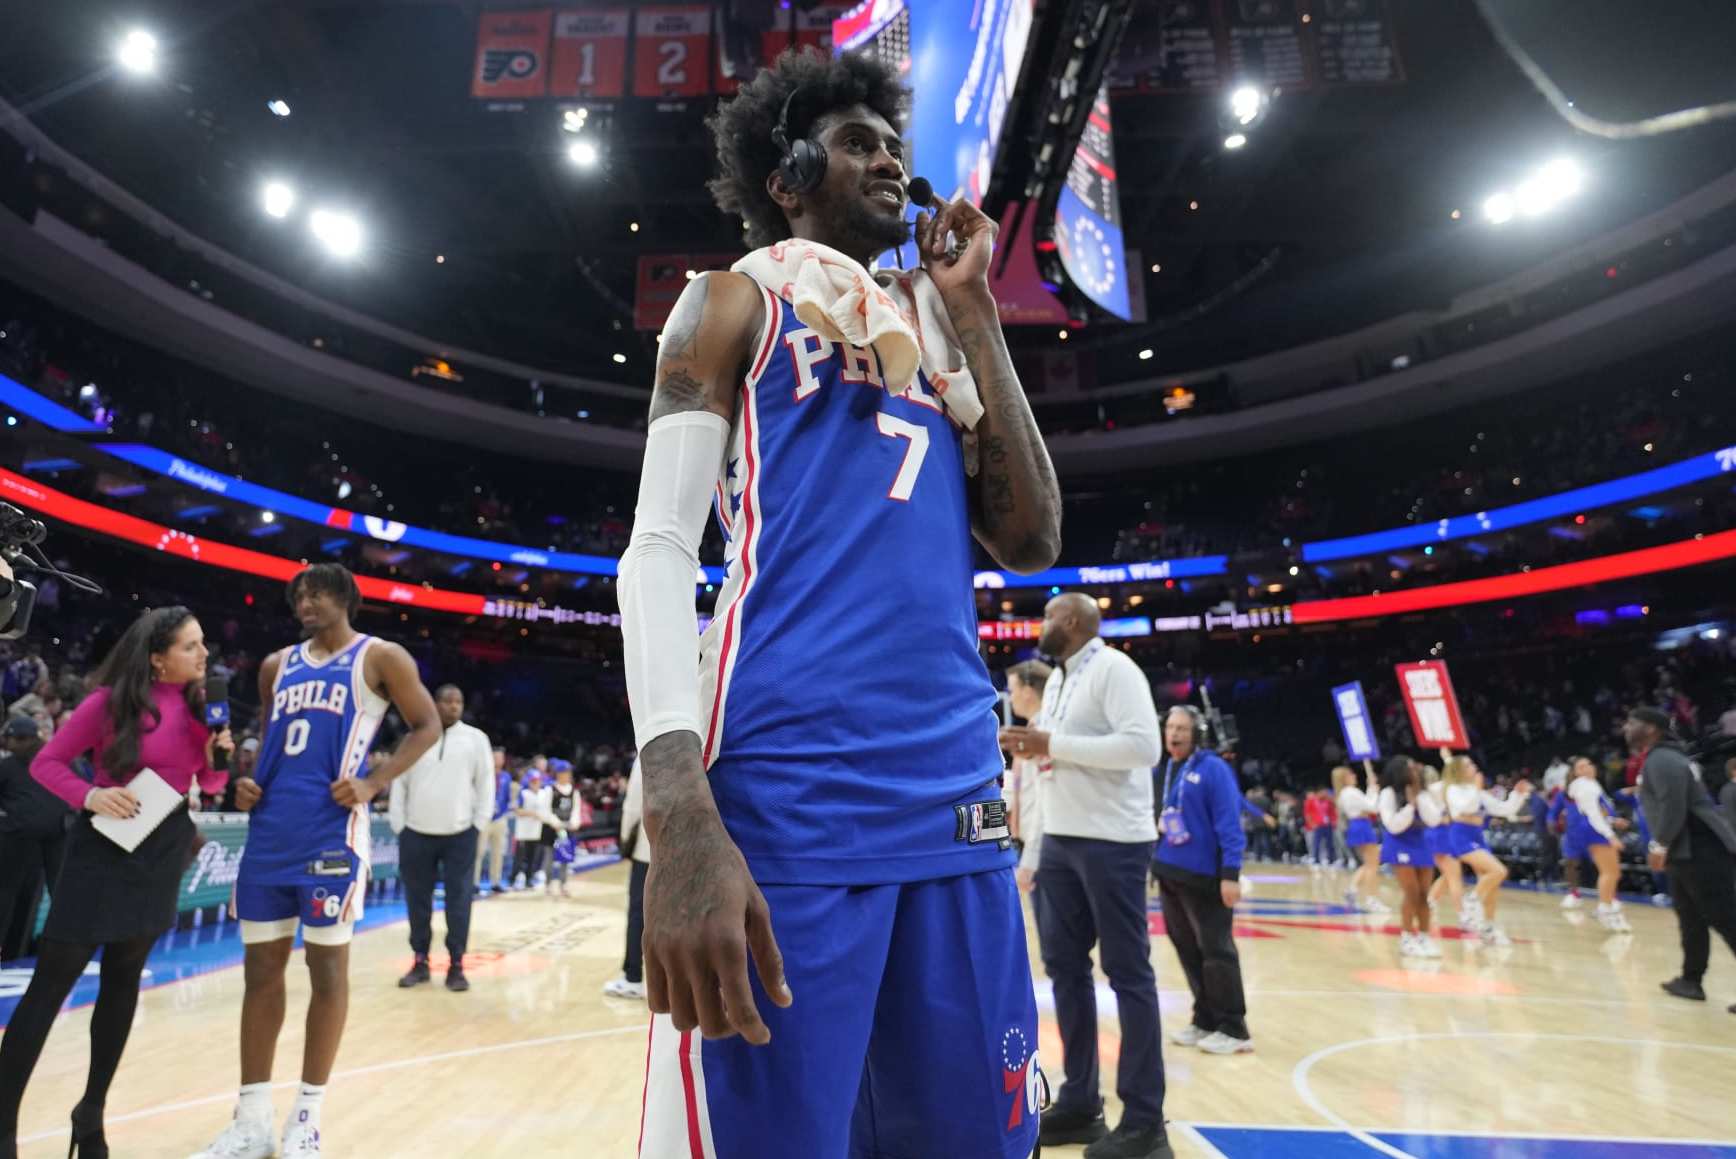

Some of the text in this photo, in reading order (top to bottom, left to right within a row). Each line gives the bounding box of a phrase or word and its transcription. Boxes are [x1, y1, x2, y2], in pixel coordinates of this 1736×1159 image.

[577, 42, 595, 84] 1
[656, 41, 687, 84] 2
[876, 410, 930, 502] 7
[1078, 567, 1126, 583] 76ers
[271, 679, 348, 723] PHILA
[284, 718, 311, 756] 0
[311, 895, 341, 919] 76
[1003, 1049, 1040, 1133] 76
